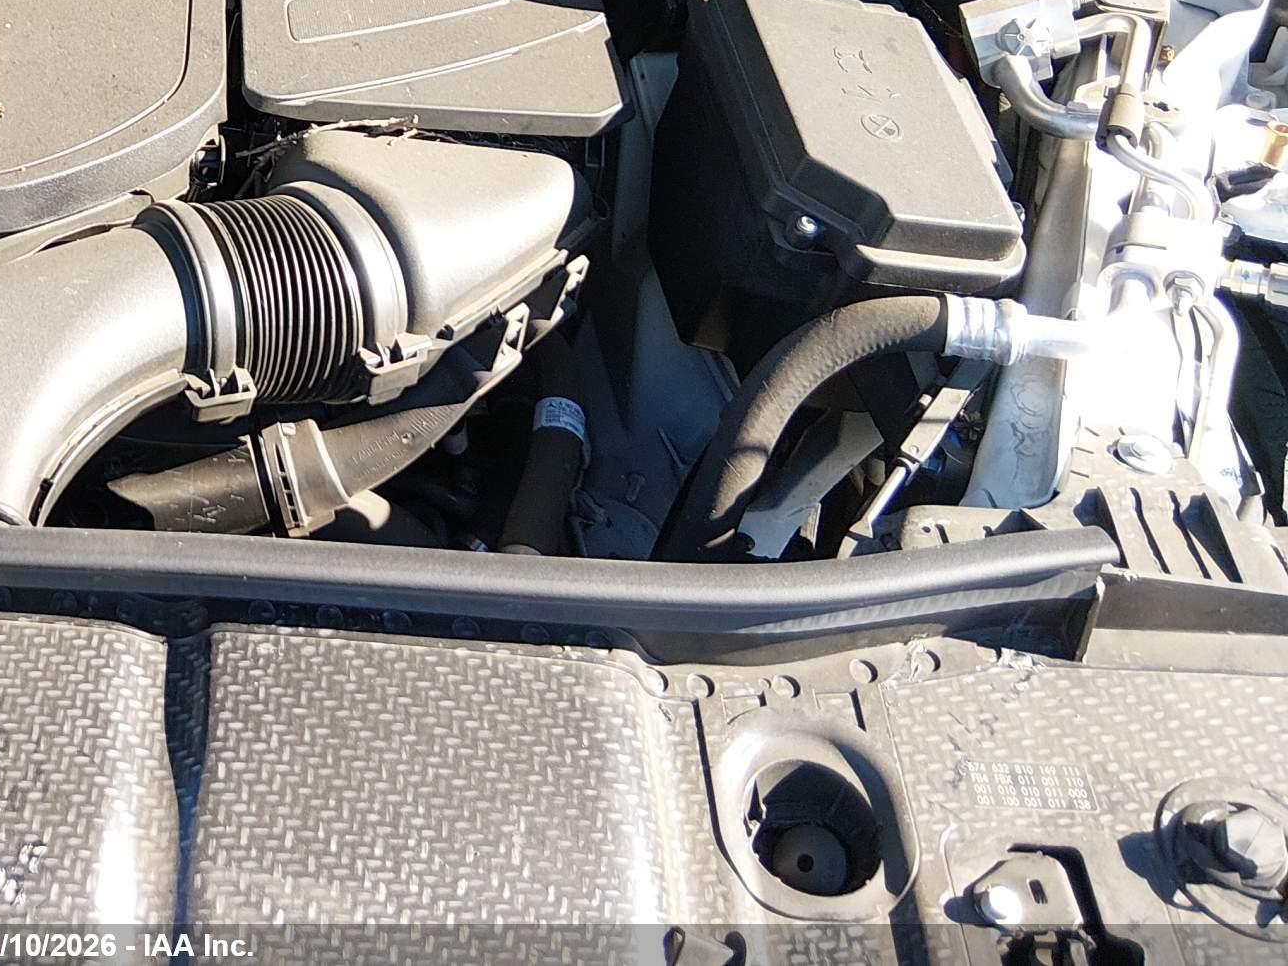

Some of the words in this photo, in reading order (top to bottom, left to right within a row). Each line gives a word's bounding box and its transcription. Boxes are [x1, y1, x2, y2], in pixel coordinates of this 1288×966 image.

[992, 763, 1010, 773] 632
[1062, 766, 1080, 776] 111
[1018, 775, 1036, 785] 011
[1041, 776, 1060, 786] 001
[1066, 777, 1084, 787] 110
[974, 783, 992, 794] 001
[997, 784, 1016, 795] 010
[1021, 785, 1040, 797] 010
[1044, 786, 1063, 797] 011
[1068, 788, 1087, 798] 000
[977, 794, 995, 805] 001
[1002, 796, 1020, 806] 100
[1023, 797, 1042, 807] 001
[1048, 798, 1066, 808] 011
